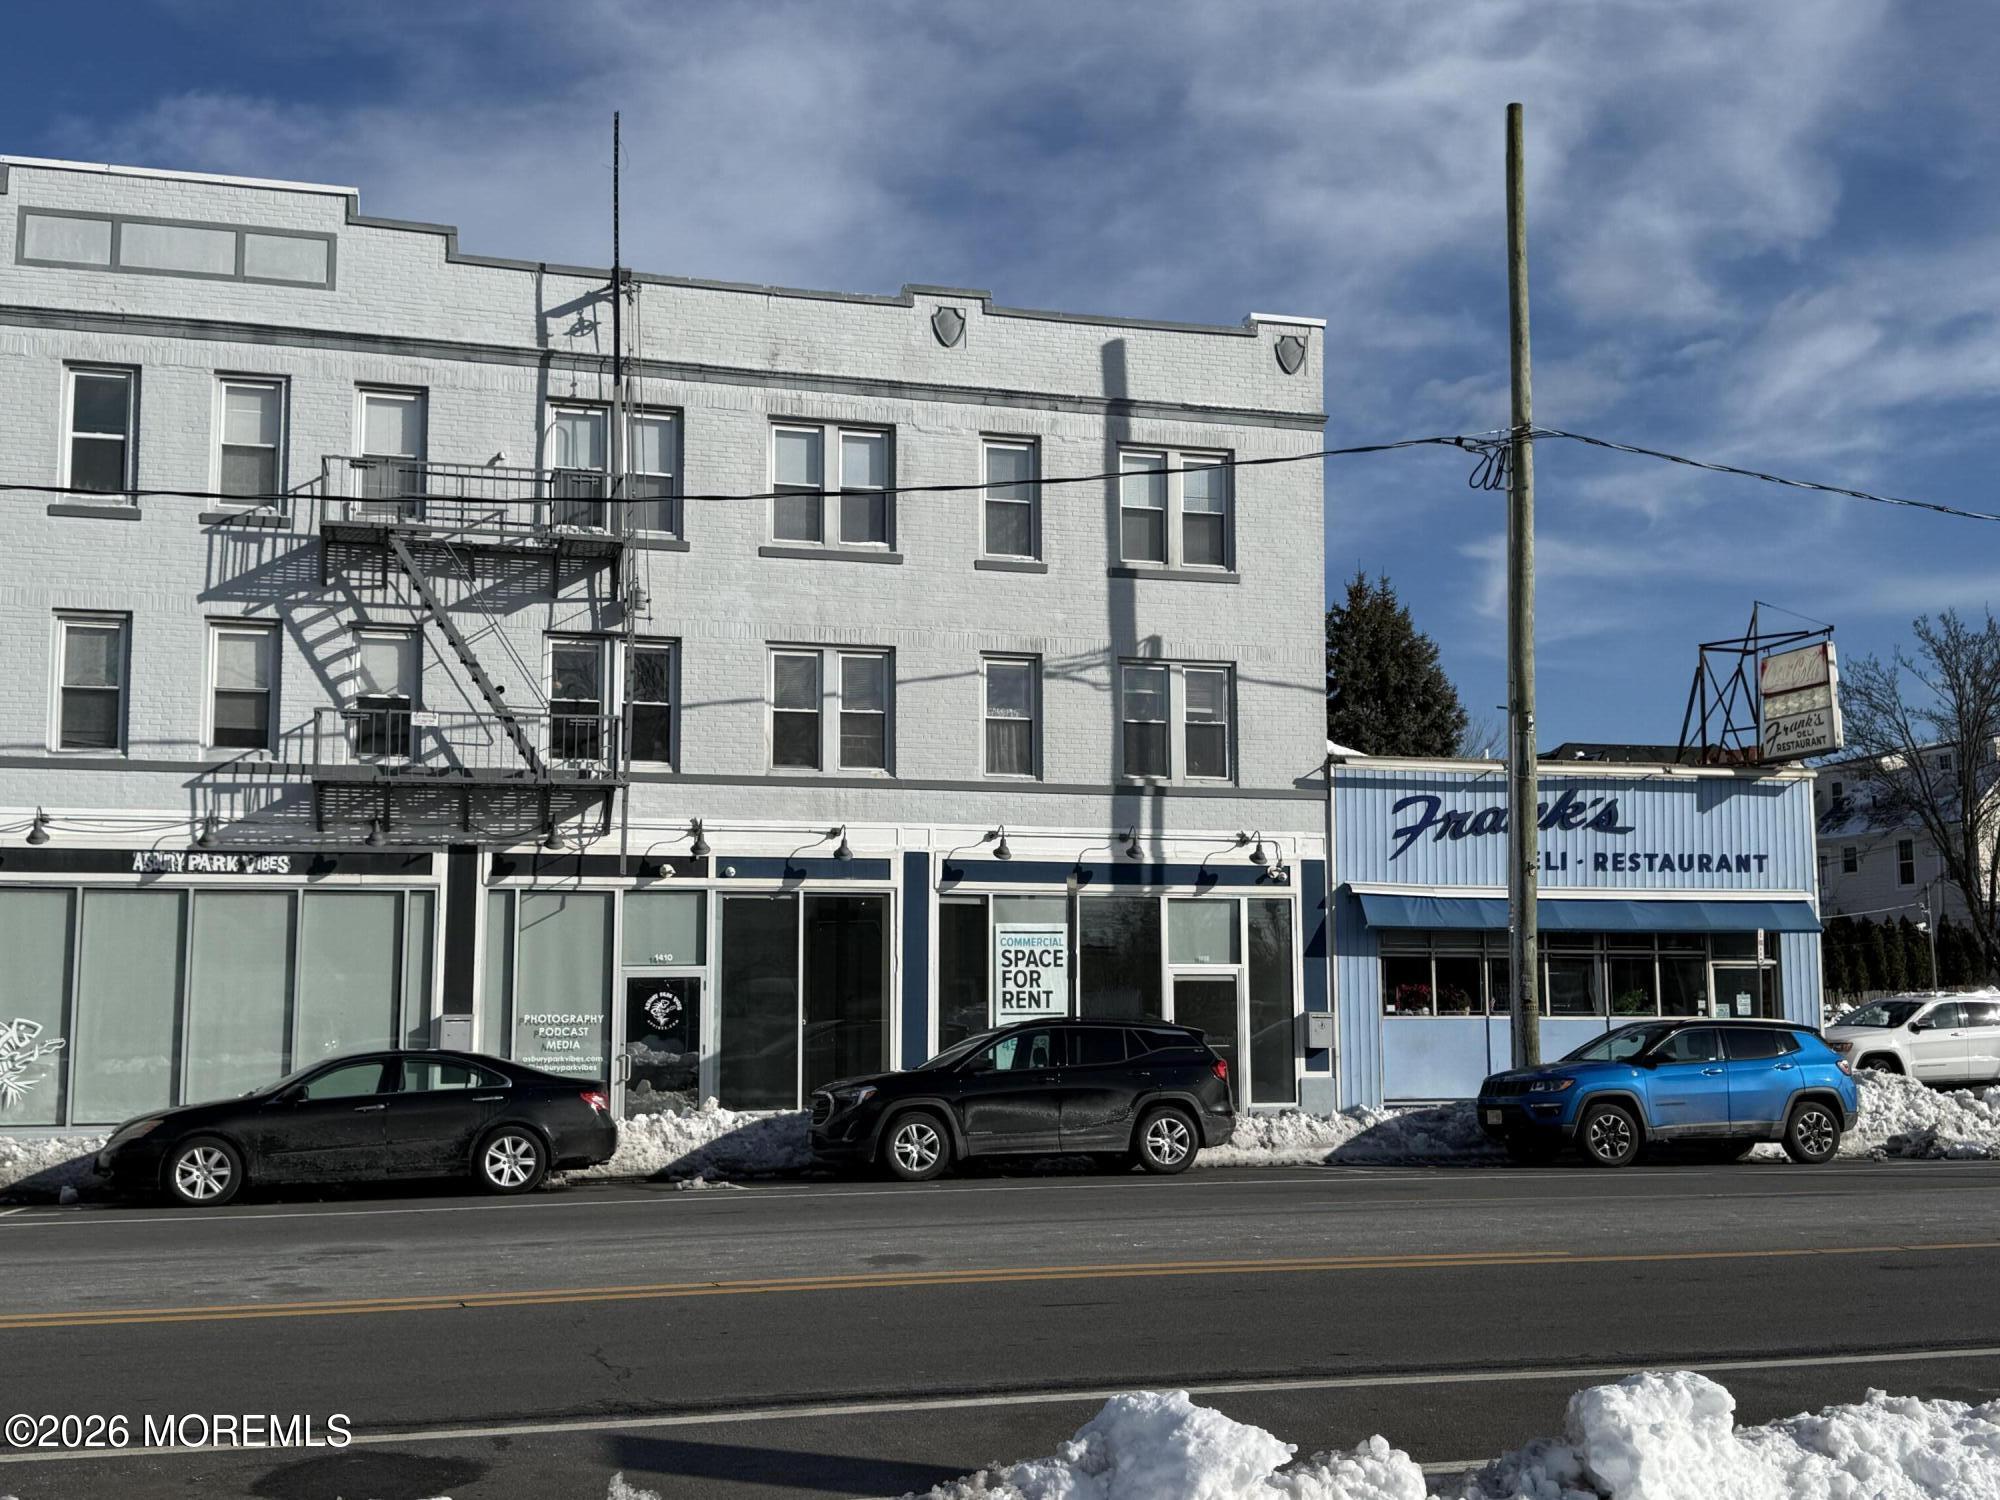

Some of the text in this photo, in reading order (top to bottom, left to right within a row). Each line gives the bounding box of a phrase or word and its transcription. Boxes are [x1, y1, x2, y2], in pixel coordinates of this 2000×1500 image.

[1765, 713, 1824, 756] Frank's
[1776, 735, 1827, 752] RESTAURANT
[1796, 729, 1815, 739] DELI
[1389, 787, 1635, 862] Frak's
[188, 853, 239, 872] PARK
[1593, 852, 1769, 873] RESTAURANT
[1000, 937, 1064, 947] COMMERCIAL
[1001, 949, 1064, 968] SPACE
[1001, 969, 1042, 988] FOR
[1001, 990, 1053, 1009] RENT
[523, 1014, 604, 1024] PHOTOGRAPHY
[538, 1027, 589, 1036] PODCAST
[546, 1040, 580, 1049] MEDIA
